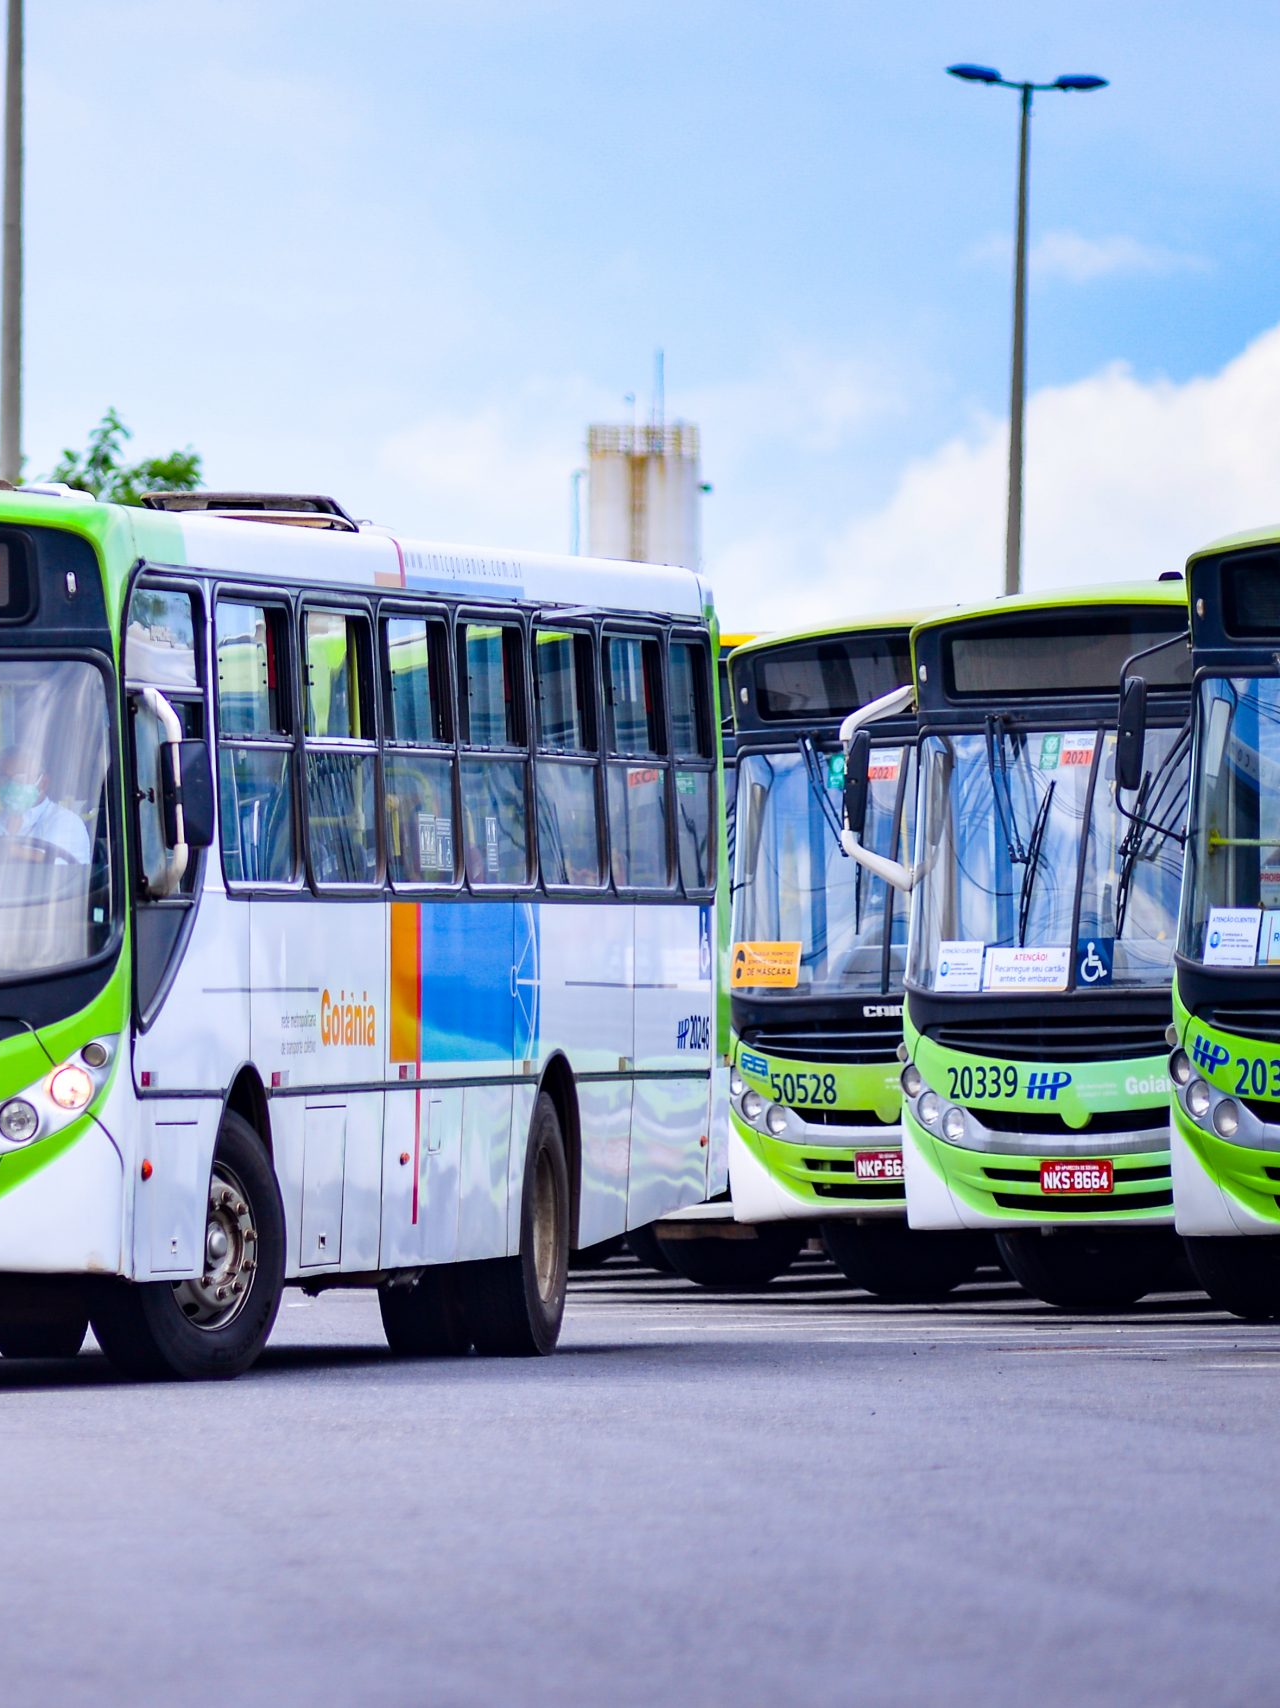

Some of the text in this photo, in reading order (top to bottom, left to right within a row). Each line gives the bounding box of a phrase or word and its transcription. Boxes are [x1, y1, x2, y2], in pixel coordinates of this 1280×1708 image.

[1065, 751, 1090, 765] 2021
[872, 766, 895, 780] 2021
[995, 965, 1030, 974] Recarregue
[1044, 965, 1066, 973] cartão
[690, 1014, 710, 1050] 20246
[770, 1073, 838, 1105] 50528
[947, 1065, 1019, 1100] 20339
